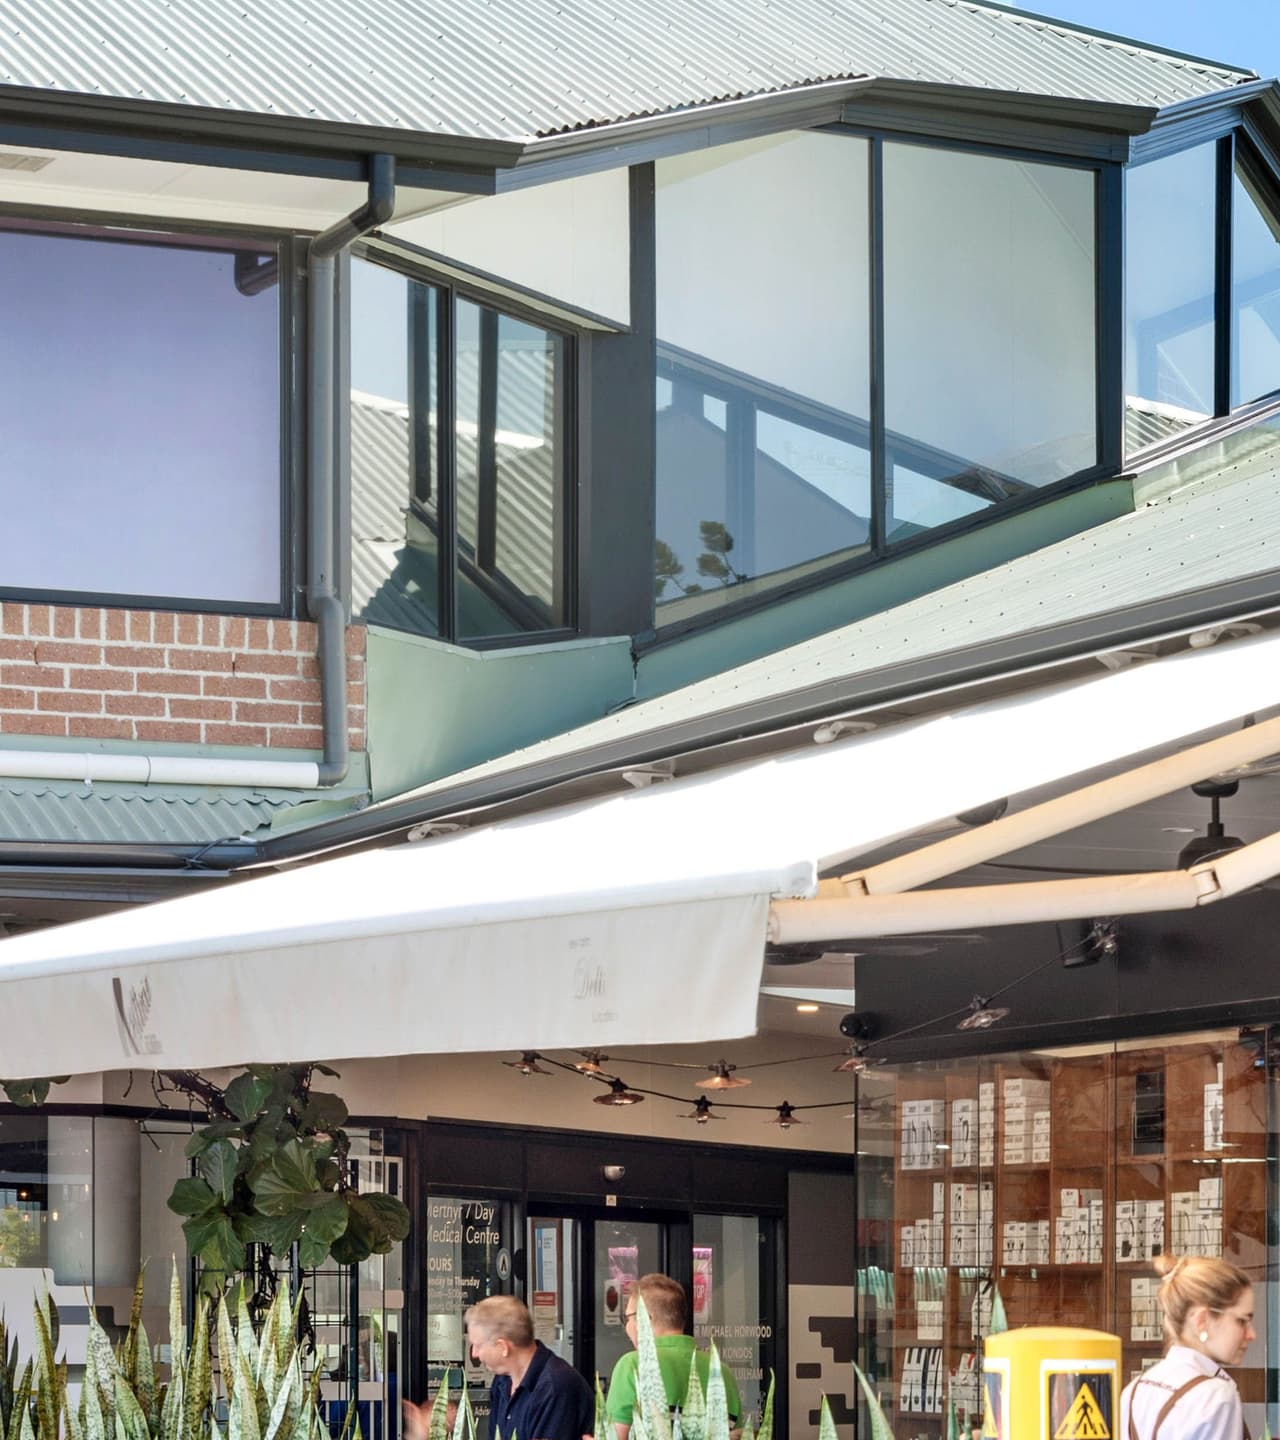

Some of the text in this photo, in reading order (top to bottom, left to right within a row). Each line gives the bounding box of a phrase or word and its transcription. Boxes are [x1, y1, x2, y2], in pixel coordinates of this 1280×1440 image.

[475, 1202, 495, 1226] Day
[466, 1225, 500, 1245] Centre
[428, 1257, 453, 1272] OURS
